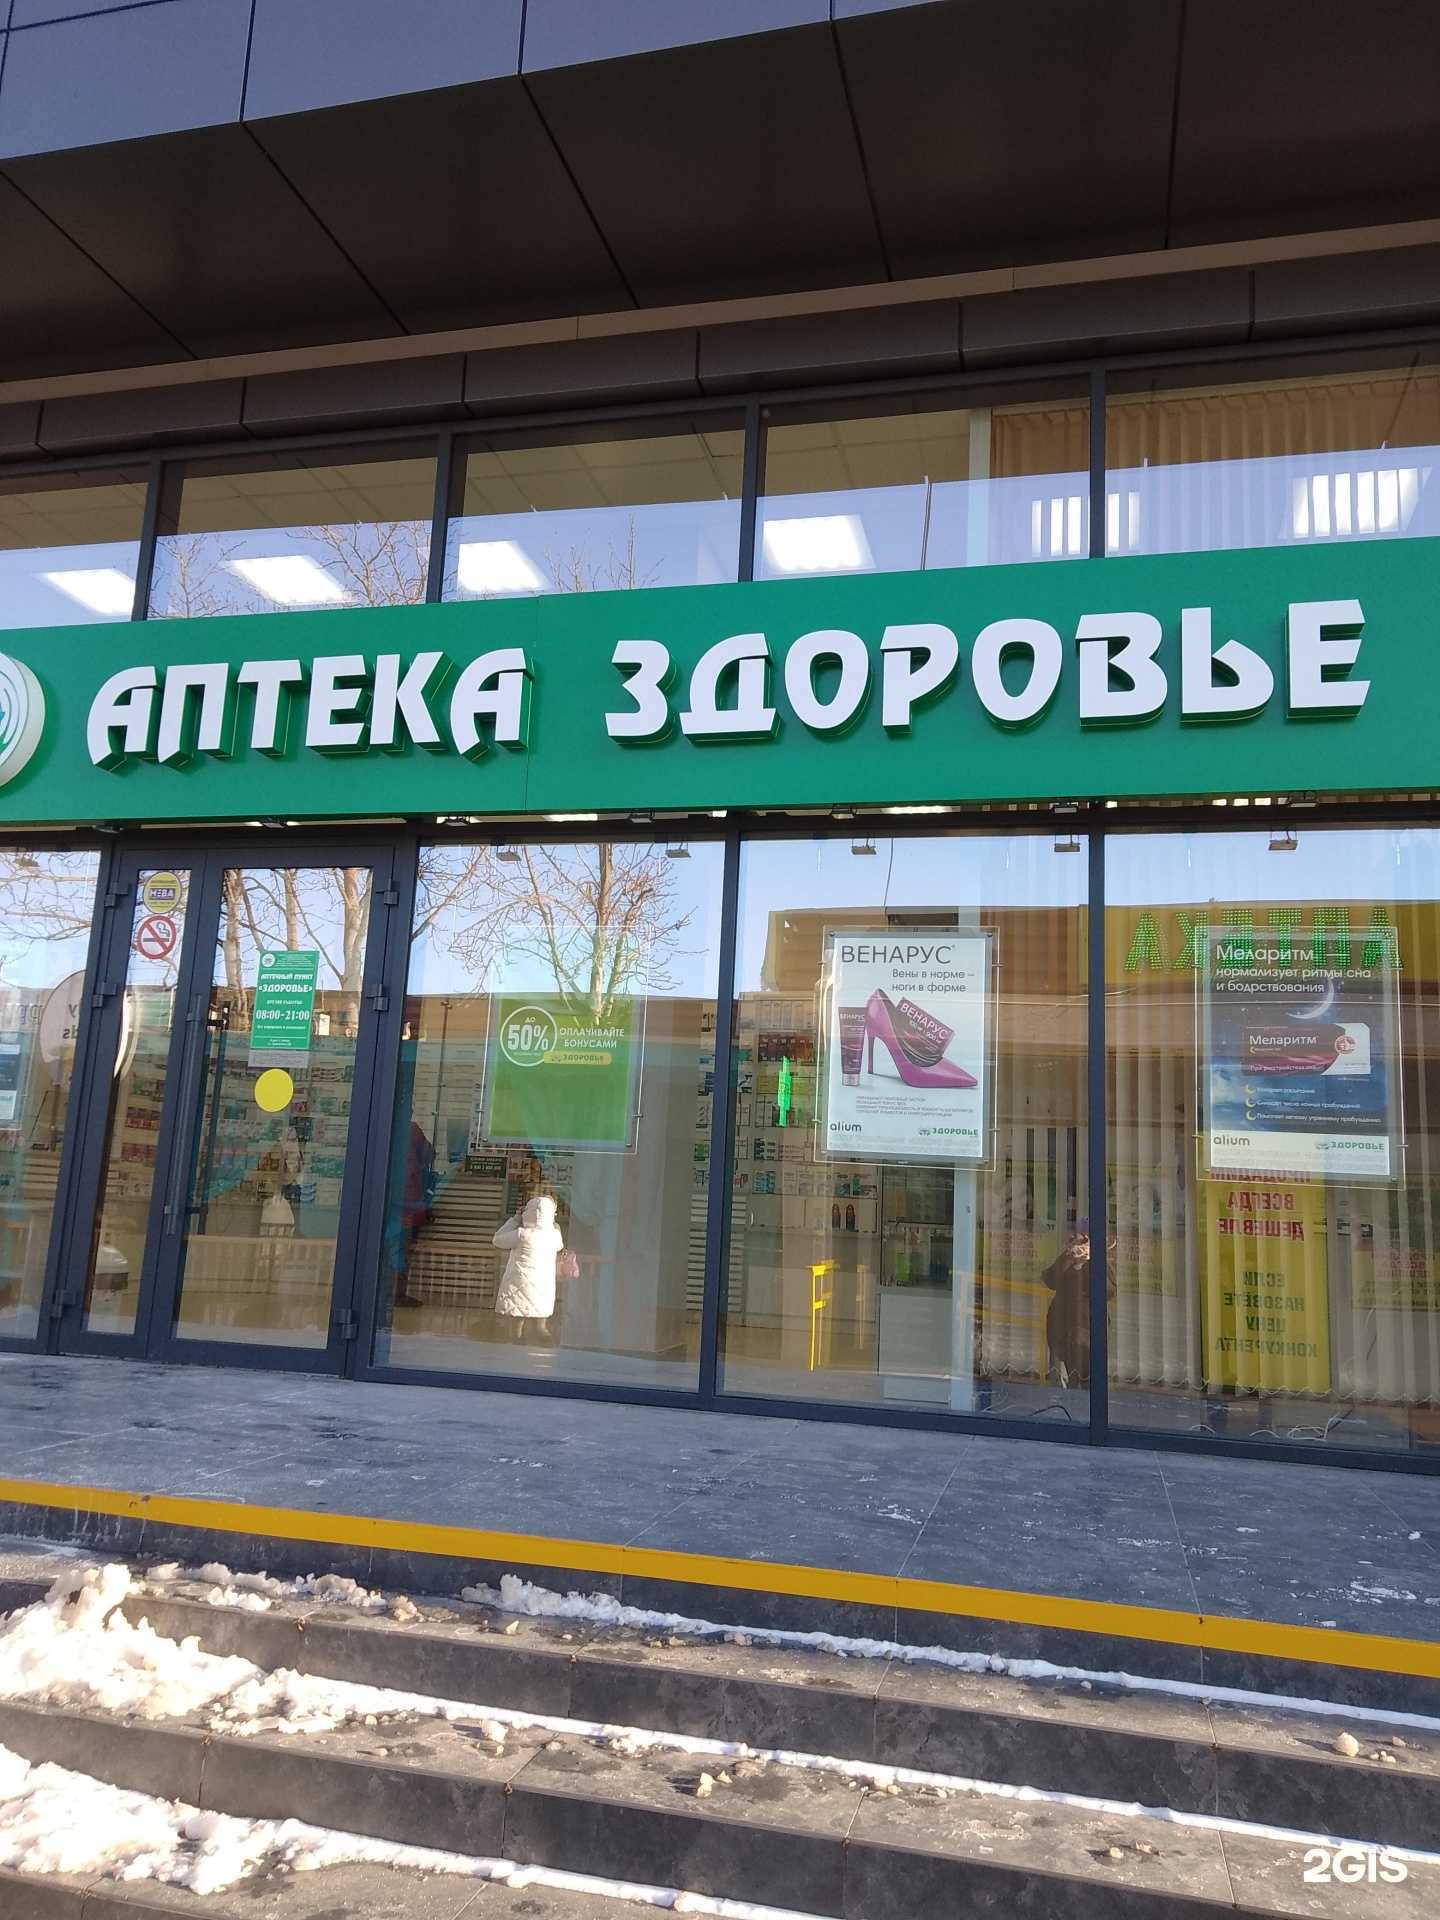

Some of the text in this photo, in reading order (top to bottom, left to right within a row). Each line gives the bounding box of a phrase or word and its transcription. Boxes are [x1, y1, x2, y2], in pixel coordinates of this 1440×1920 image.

[87, 600, 1370, 765] АПТЕКА ЗДОРОВЬЕ
[841, 944, 952, 964] ВЕНАРУС
[892, 969, 918, 978] Вены
[921, 970, 927, 978] в
[930, 971, 966, 981] норме
[1216, 968, 1371, 980] нормализует ритмы сна
[892, 982, 966, 994] ноги в форме
[1216, 980, 1324, 993] и бодрствования
[507, 1024, 549, 1051] 50%
[559, 1026, 625, 1038] ОПЛАЧИВАЙТЕ
[564, 1039, 617, 1049] БОНУСАМИ
[1249, 1035, 1318, 1047] Меларитм
[830, 1121, 862, 1133] alium
[1213, 1135, 1250, 1146] alium
